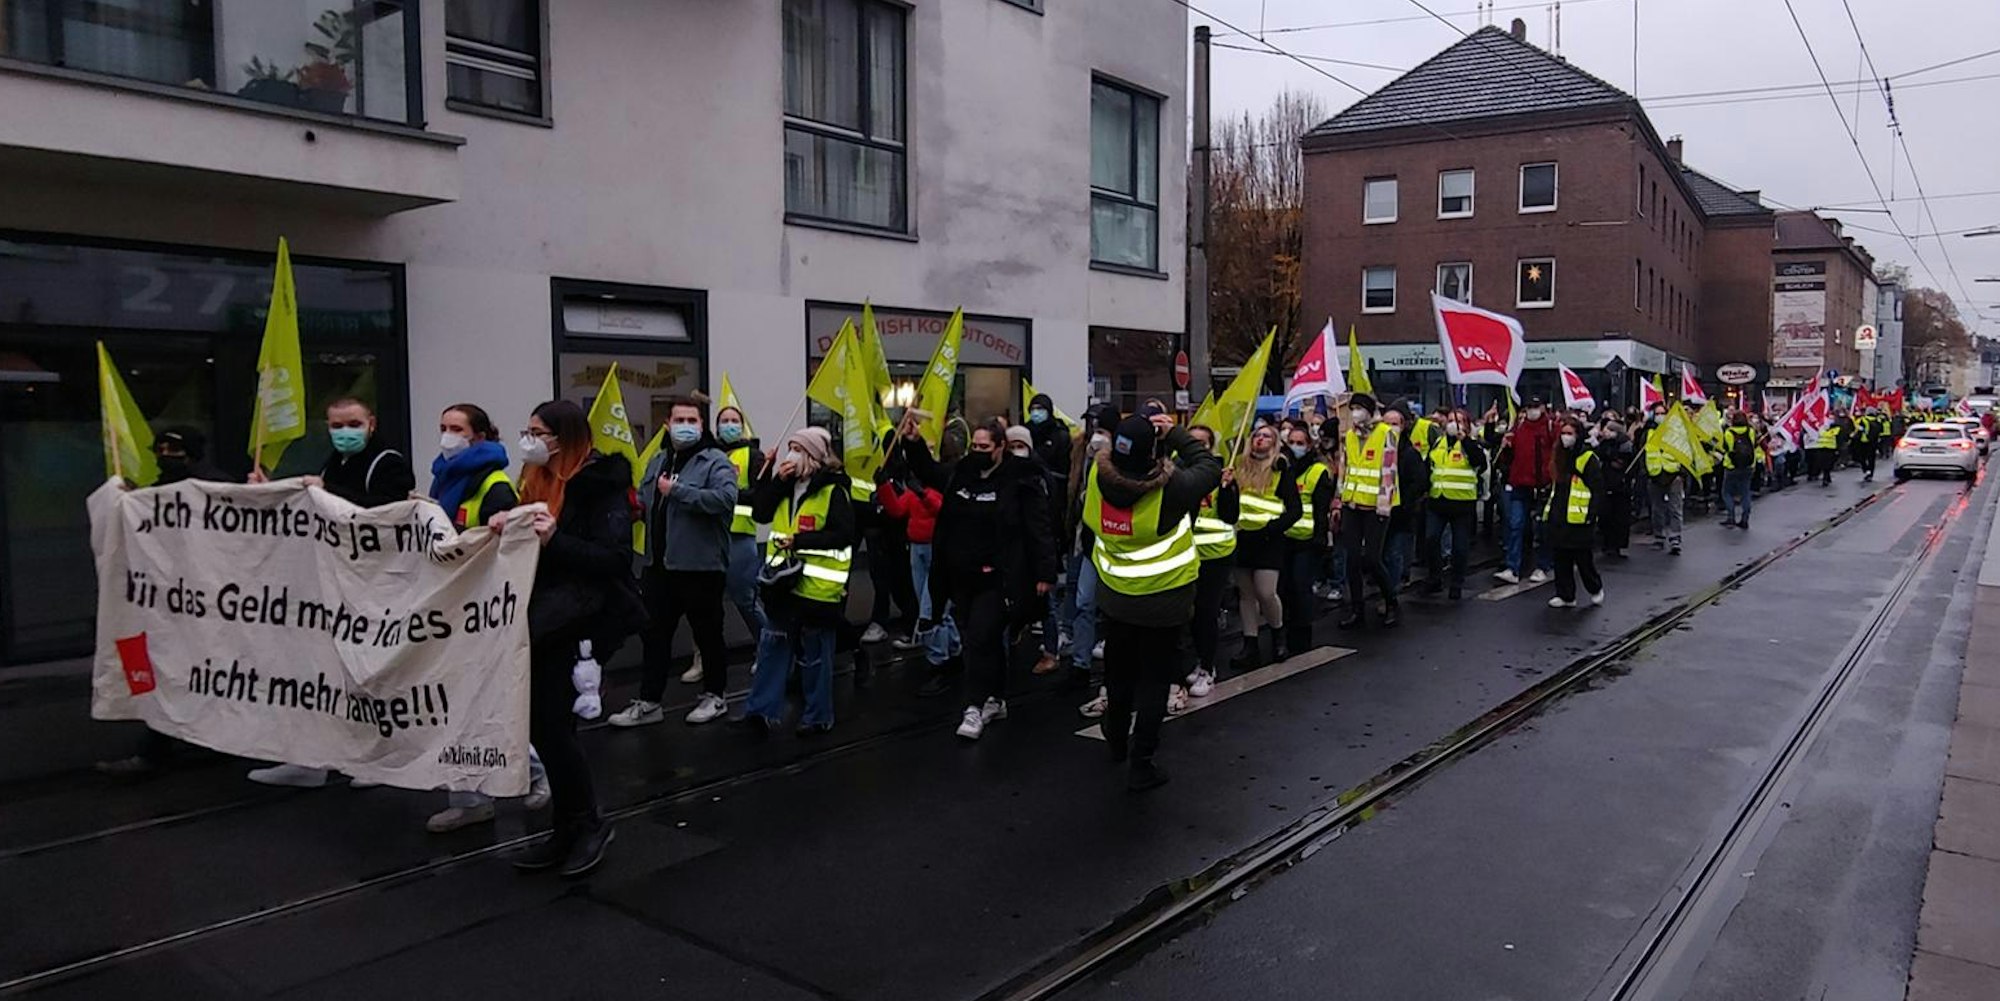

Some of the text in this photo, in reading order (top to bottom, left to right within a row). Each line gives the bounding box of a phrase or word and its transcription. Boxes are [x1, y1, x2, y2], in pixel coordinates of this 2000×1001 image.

[204, 494, 309, 537] könnte
[349, 513, 381, 560] ja
[166, 577, 206, 618] das
[217, 583, 287, 625] Geld
[407, 611, 452, 643] es
[188, 658, 260, 703] nicht
[267, 673, 343, 716] mehr
